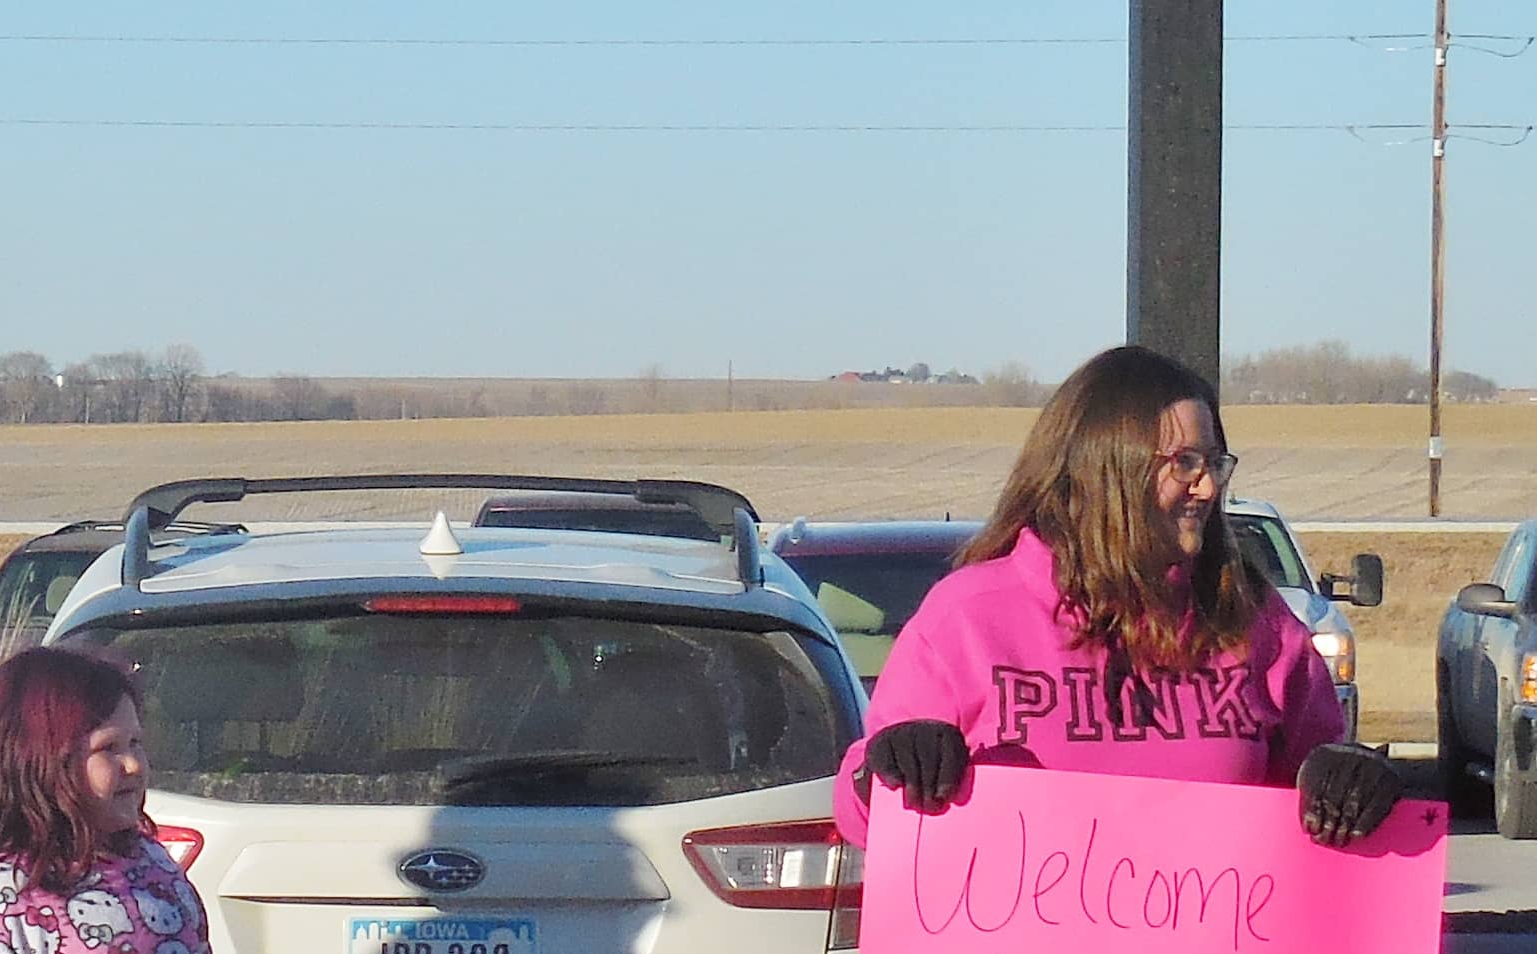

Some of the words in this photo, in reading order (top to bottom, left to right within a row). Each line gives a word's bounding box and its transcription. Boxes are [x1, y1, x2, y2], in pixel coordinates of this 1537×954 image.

[992, 664, 1262, 744] PINK
[913, 810, 1276, 952] Welcome
[415, 921, 470, 939] IOWA
